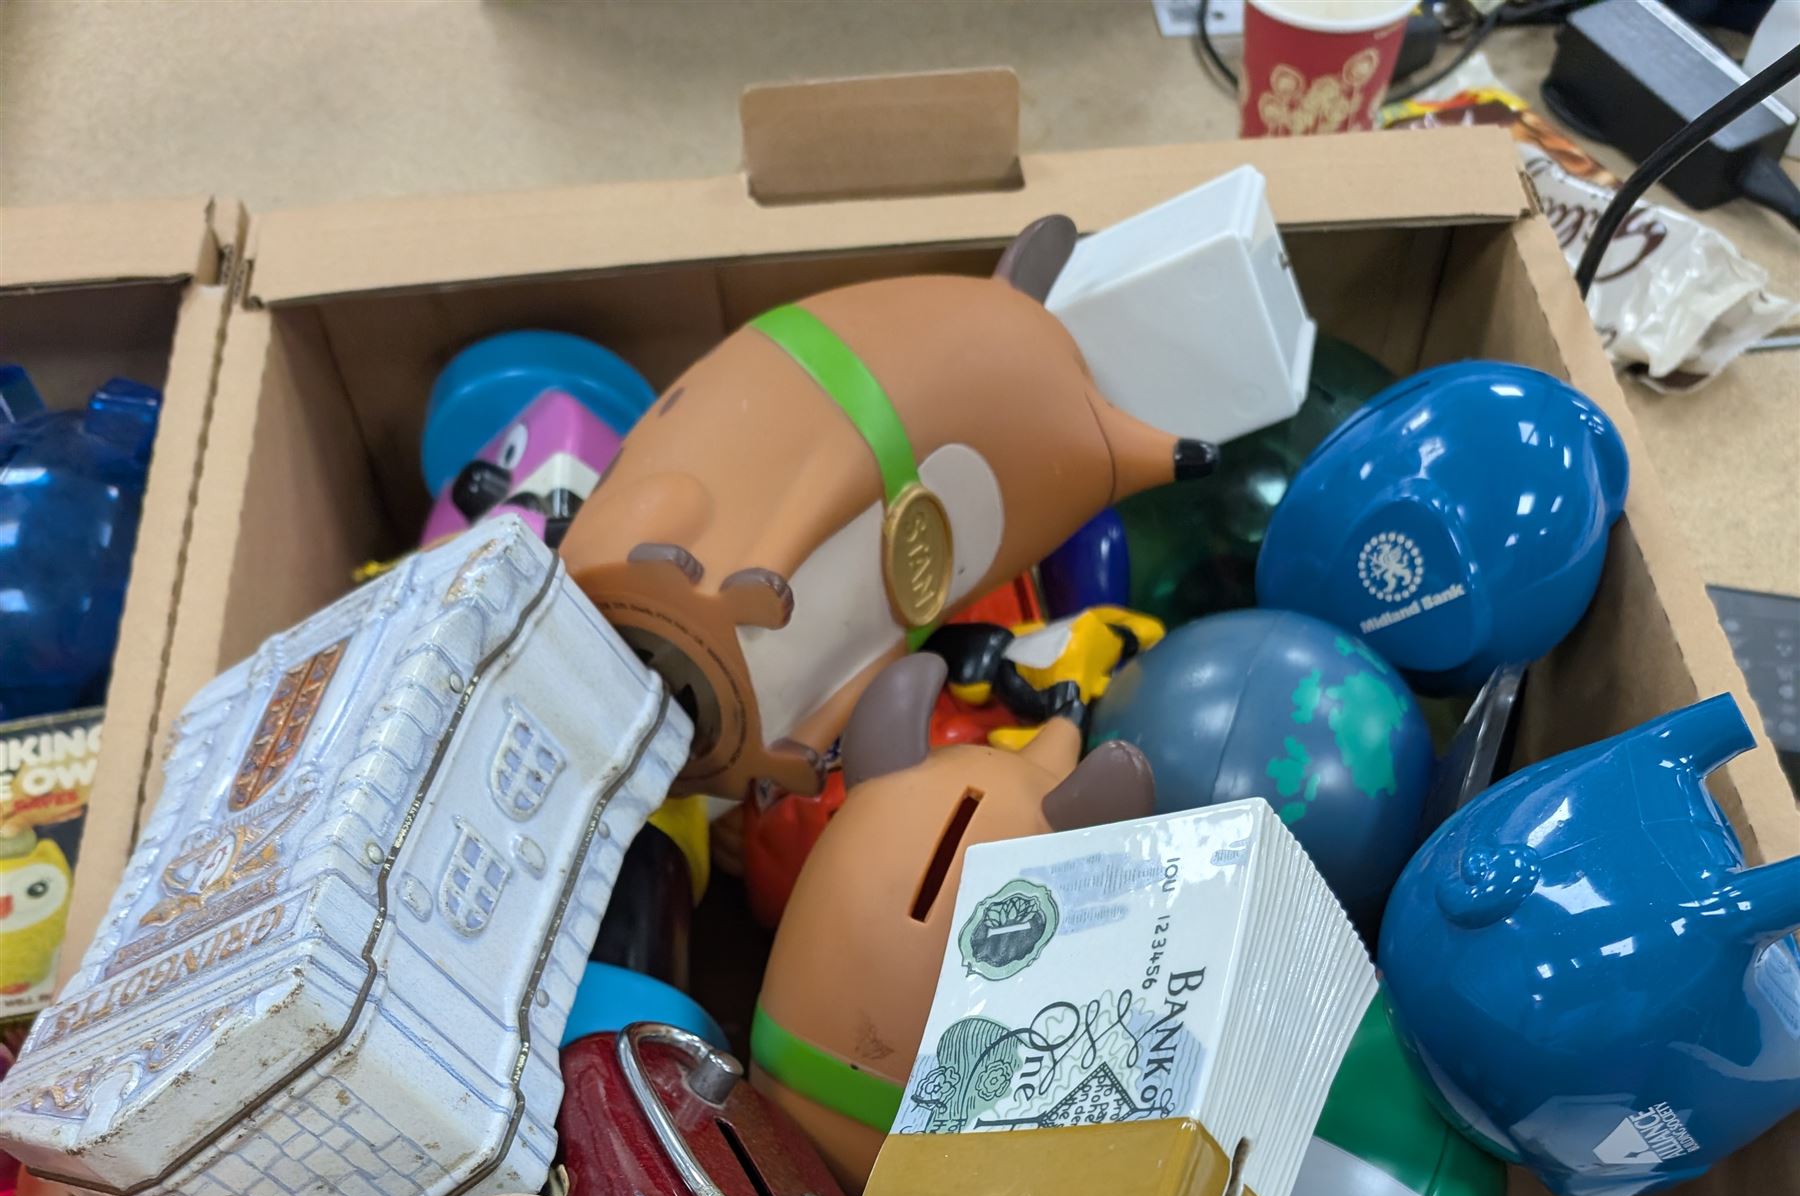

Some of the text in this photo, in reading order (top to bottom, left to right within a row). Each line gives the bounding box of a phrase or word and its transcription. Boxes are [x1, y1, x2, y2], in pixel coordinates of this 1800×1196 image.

[1421, 583, 1466, 610] Bank
[52, 903, 284, 1041] GRINGOTTS
[1141, 857, 1181, 990] IOU 123456
[1013, 1001, 1082, 1102] One
[1143, 966, 1206, 1081] BANK
[1629, 1106, 1687, 1160] ALLIANCE
